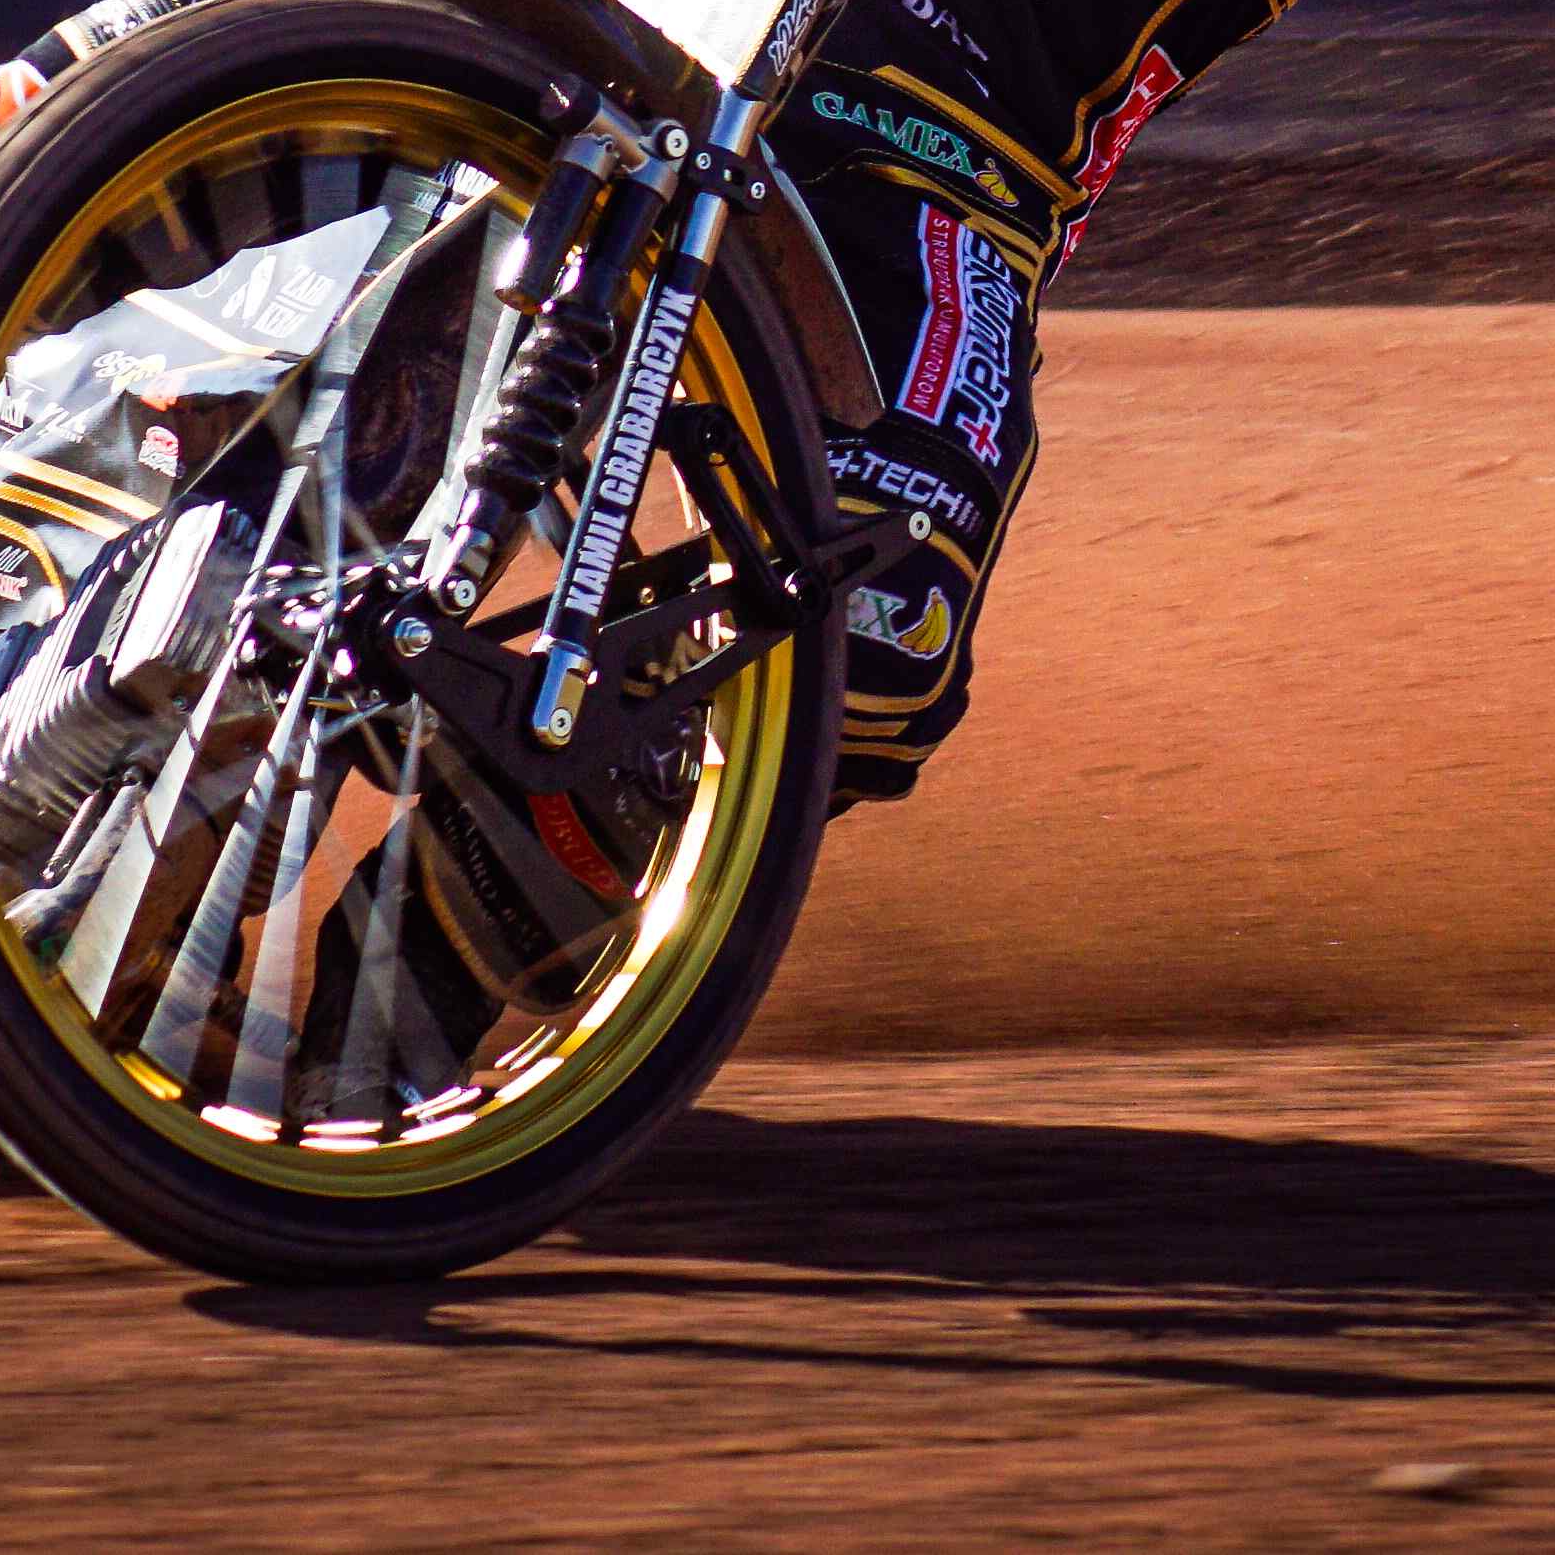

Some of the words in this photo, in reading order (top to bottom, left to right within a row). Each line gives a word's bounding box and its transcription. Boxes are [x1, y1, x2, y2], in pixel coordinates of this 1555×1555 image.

[811, 91, 977, 178] GAMEX
[564, 509, 629, 618] KAMIL
[598, 284, 696, 507] GRABARCZYK
